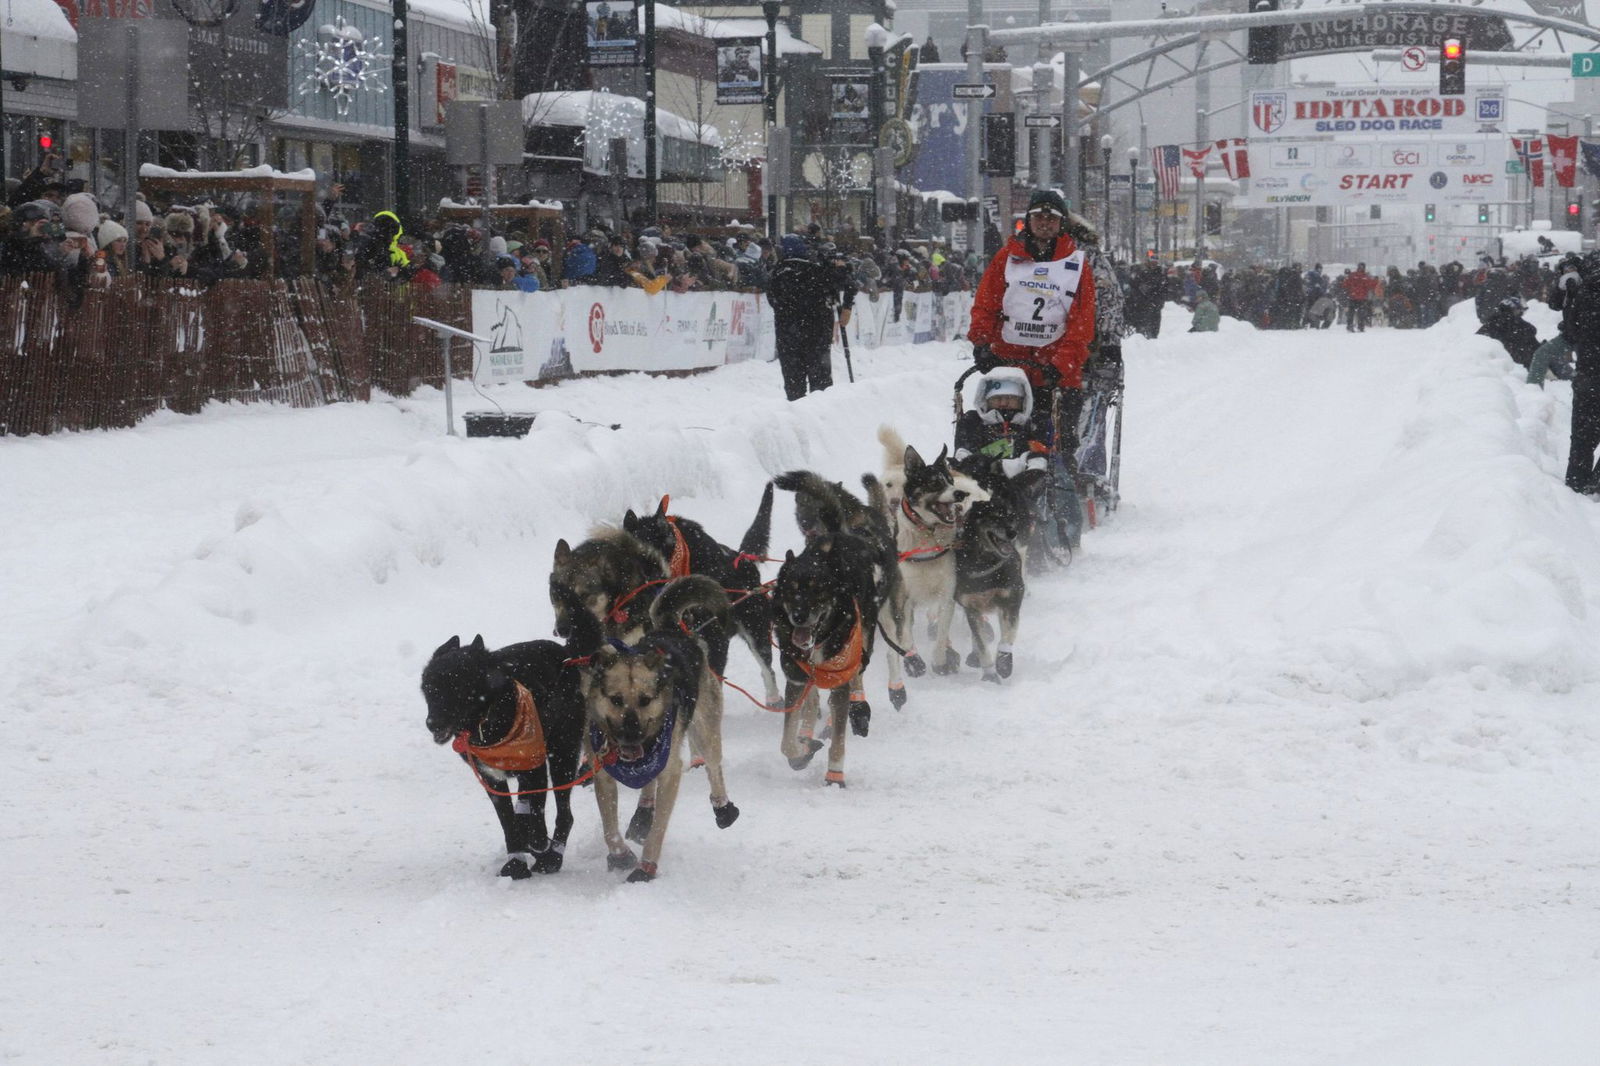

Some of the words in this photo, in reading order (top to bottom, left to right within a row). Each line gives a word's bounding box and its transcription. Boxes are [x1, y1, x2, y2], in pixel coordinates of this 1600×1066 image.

[1290, 14, 1469, 39] ANCHORAGE
[1283, 32, 1380, 52] MUSHING
[1385, 32, 1474, 49] DISTRT
[1582, 58, 1593, 73] D
[1341, 89, 1357, 97] Last
[1358, 89, 1378, 97] Great
[1380, 88, 1398, 96] Race
[1294, 98, 1466, 120] IDITAROD
[1315, 120, 1356, 132] SLED
[1360, 119, 1395, 131] DOG
[1399, 119, 1443, 131] RACE
[1393, 152, 1420, 165] GCI
[1339, 173, 1413, 190] START
[1463, 174, 1494, 184] NAC
[1019, 281, 1060, 291] DONLIN
[1032, 297, 1045, 321] 2
[1015, 321, 1046, 333] IDITAROD
